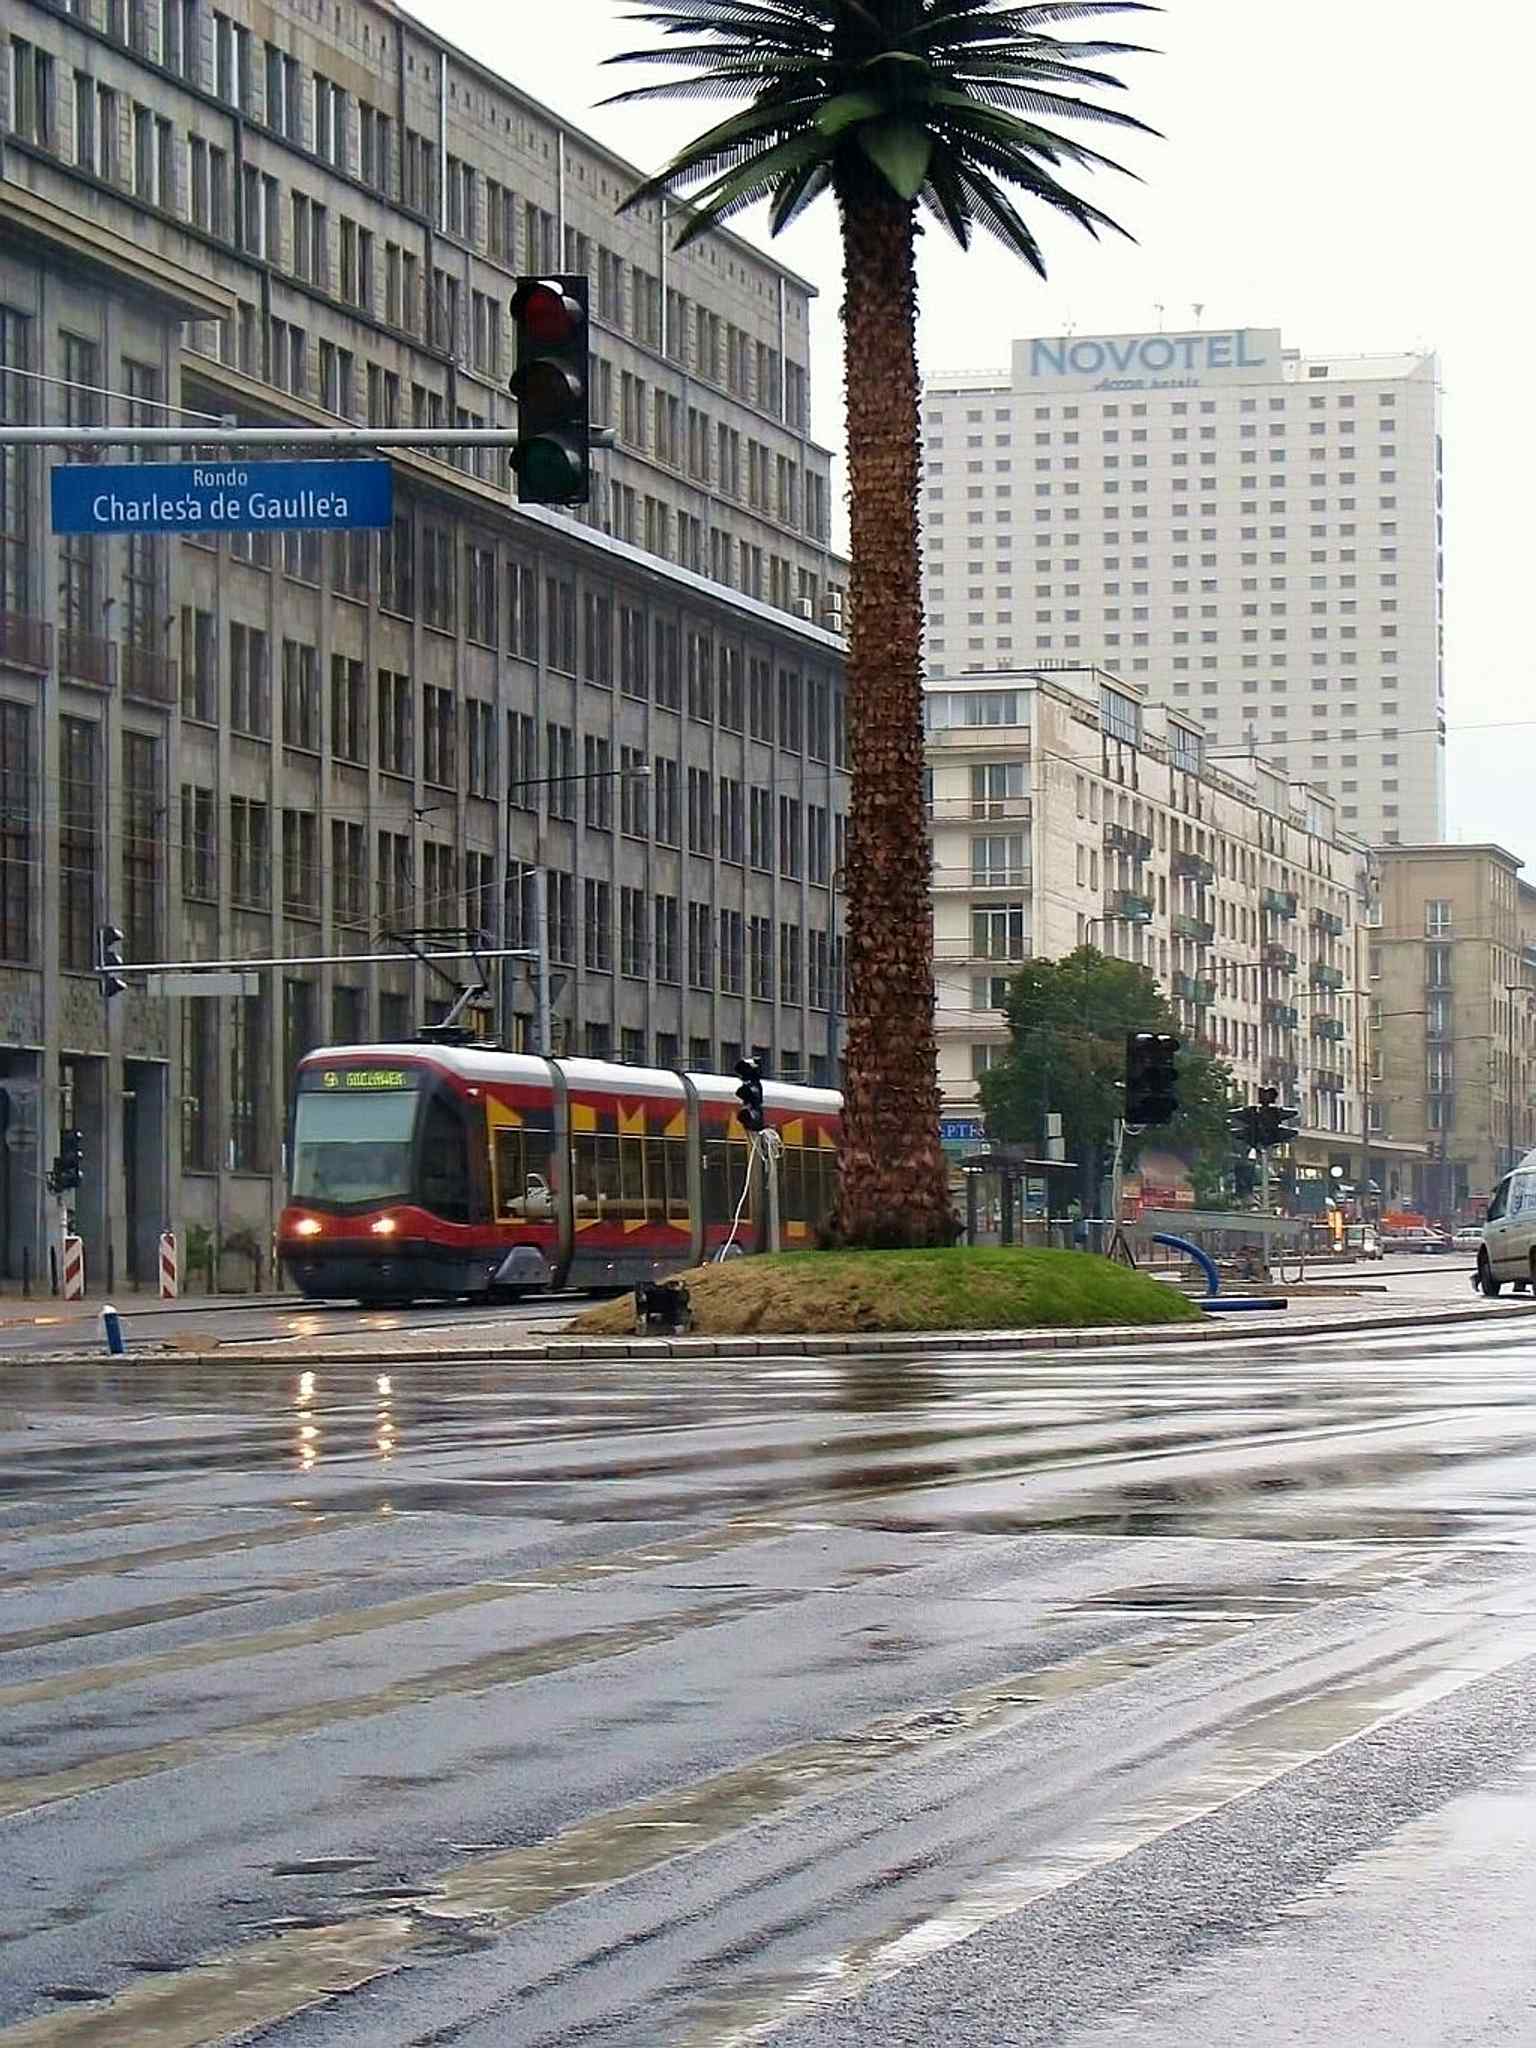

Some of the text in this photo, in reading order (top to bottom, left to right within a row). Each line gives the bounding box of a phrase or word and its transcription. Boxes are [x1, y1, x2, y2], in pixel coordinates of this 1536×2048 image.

[1030, 329, 1266, 377] NOVOTEL
[193, 468, 248, 488] Rondo
[93, 490, 349, 521] Charles'a de Gaulle'a
